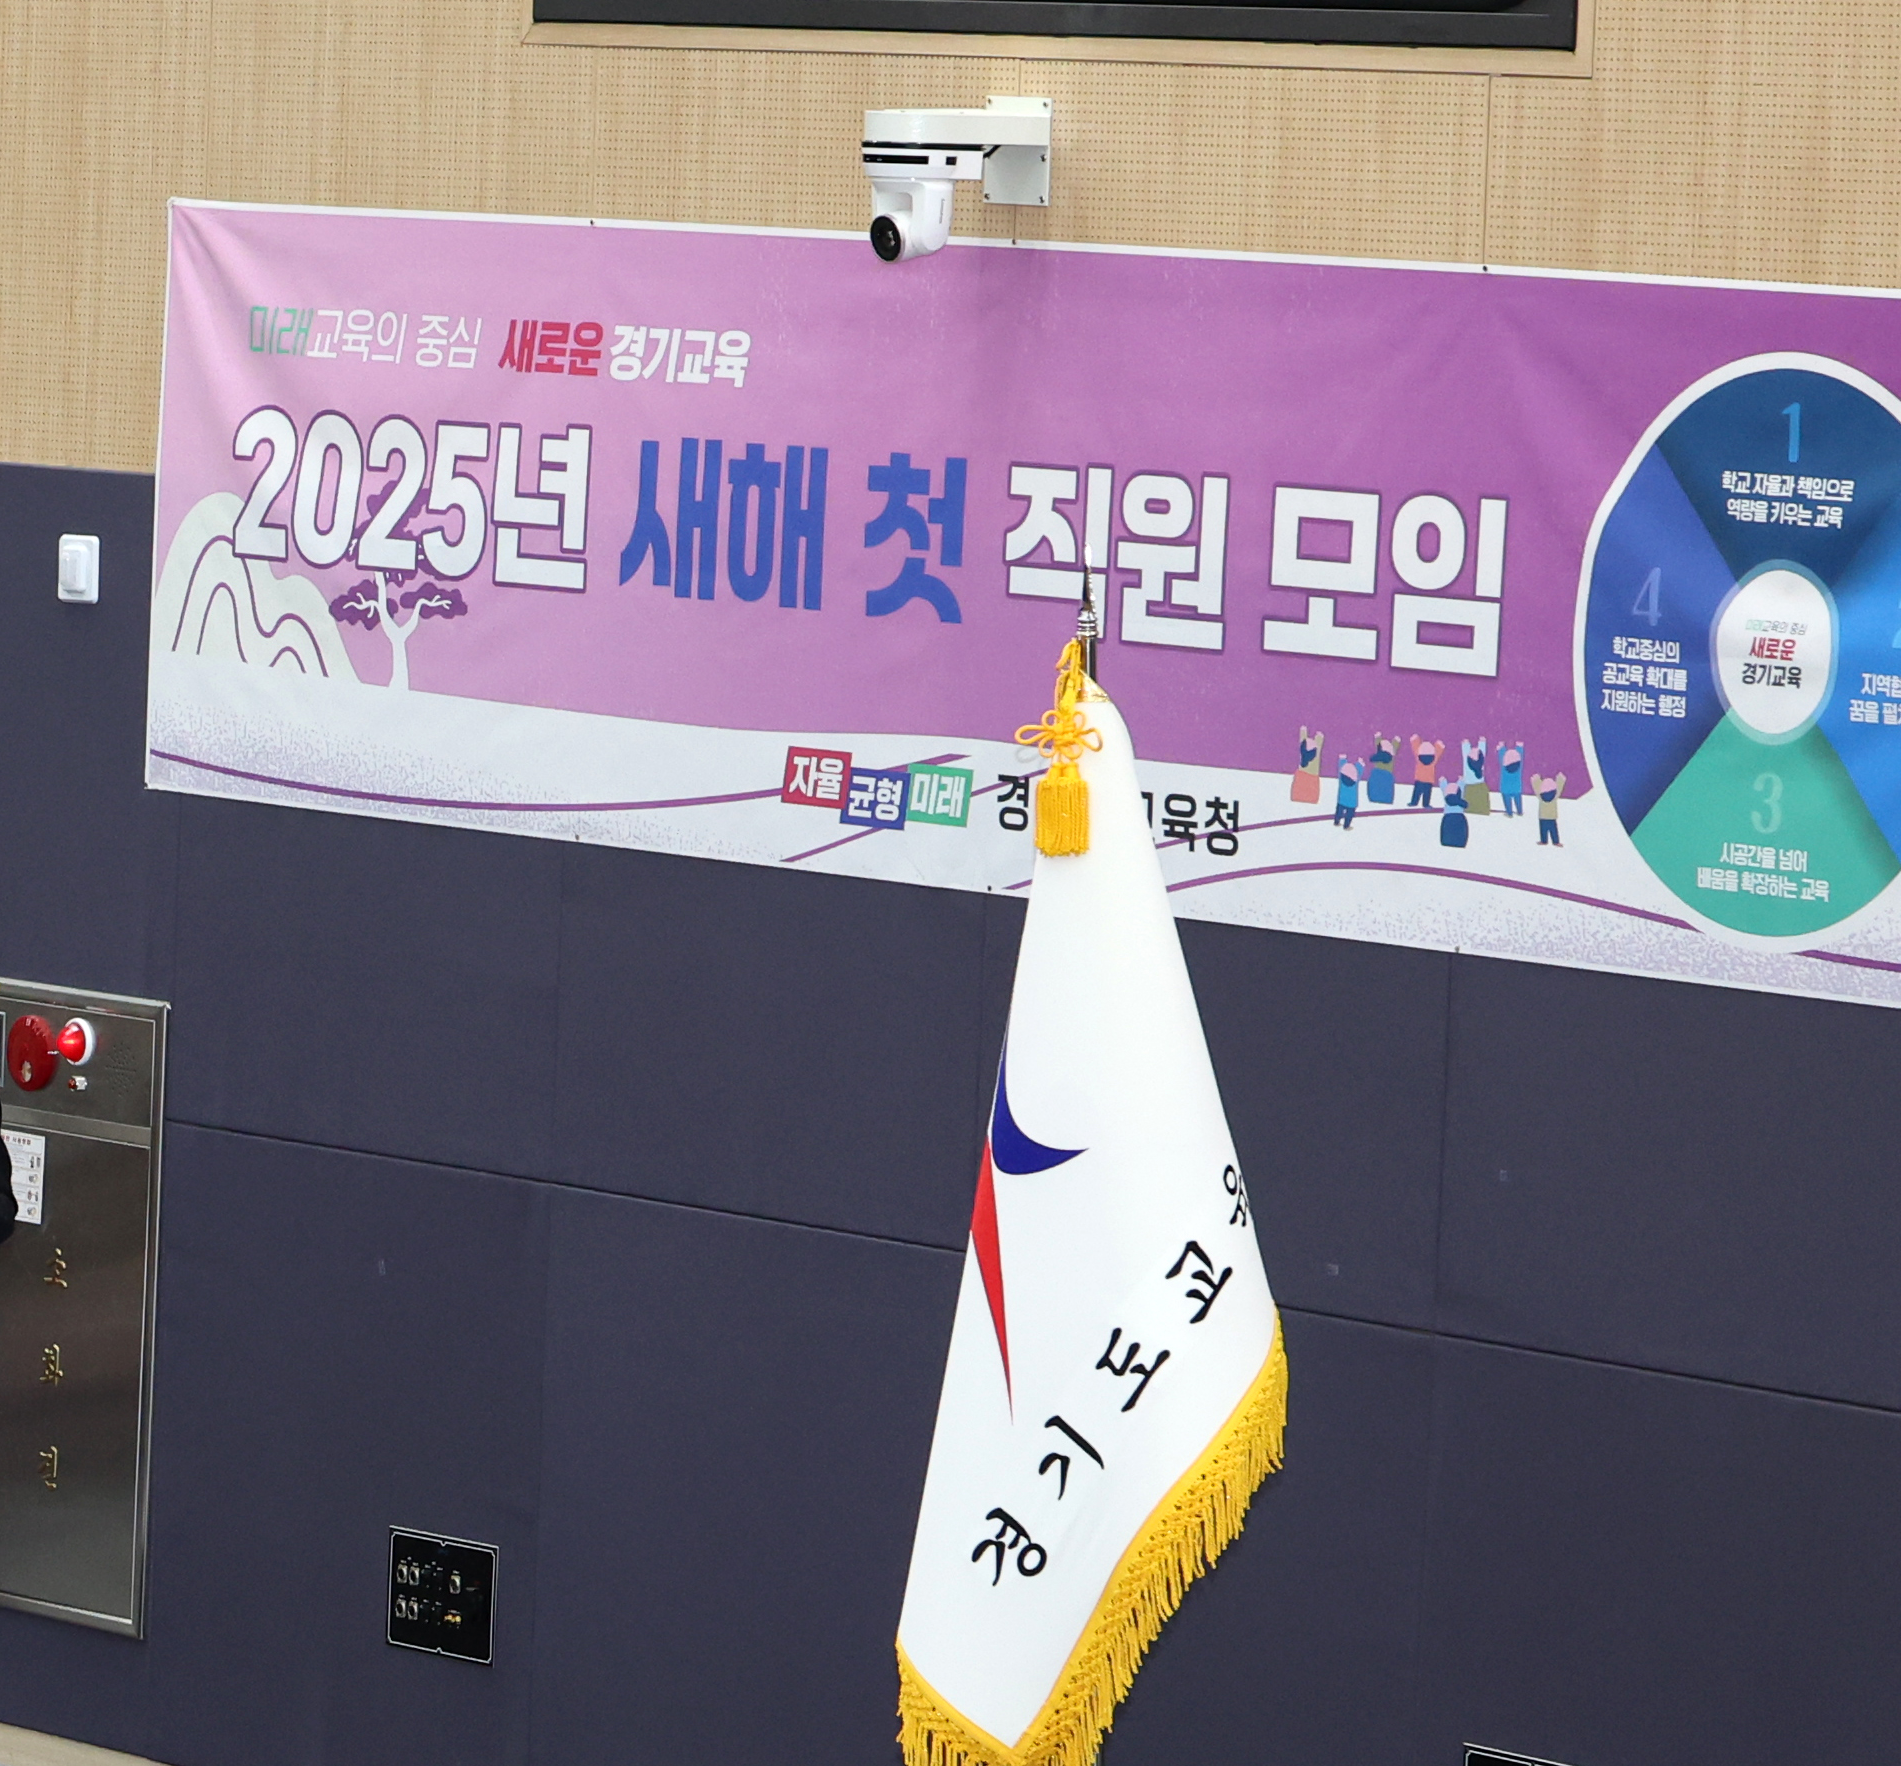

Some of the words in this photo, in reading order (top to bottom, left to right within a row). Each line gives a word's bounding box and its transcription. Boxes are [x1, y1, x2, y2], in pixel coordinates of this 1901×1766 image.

[249, 306, 407, 365] 미래교육의
[416, 313, 483, 369] 중심
[498, 319, 604, 377] 새로운
[609, 323, 752, 388] 경기교육
[1781, 401, 1801, 463] 1
[1722, 470, 1752, 494] 학교
[1751, 472, 1795, 497] 자율과
[1797, 475, 1855, 502] 책임으로
[1726, 498, 1769, 523] 역량을
[1770, 501, 1813, 527] 키우는
[1813, 505, 1844, 529] 교육
[233, 405, 593, 593] 2025년
[619, 437, 829, 611] 새해
[864, 452, 968, 624] 첫
[1003, 464, 1231, 652] 직원
[1261, 484, 1508, 677] 모임
[1631, 566, 1662, 627] 4
[1612, 636, 1681, 664] 학교중심의
[1748, 636, 1797, 661] 새로운
[1602, 662, 1644, 688] 공교육
[1645, 664, 1689, 692] 확대를
[1741, 662, 1803, 689] 경기교육
[1600, 688, 1656, 716] 지원하는
[1657, 694, 1687, 719] 행정
[1848, 699, 1880, 724] 꿈을
[788, 756, 844, 801] 자율
[847, 775, 903, 823] 균형
[909, 769, 966, 820] 미래
[1750, 771, 1785, 834] 3
[1719, 841, 1776, 870] 시공간을
[1779, 848, 1808, 873] 넘어
[1696, 866, 1739, 893] 배움을
[1740, 871, 1798, 899] 확장하는
[1800, 878, 1830, 903] 교육
